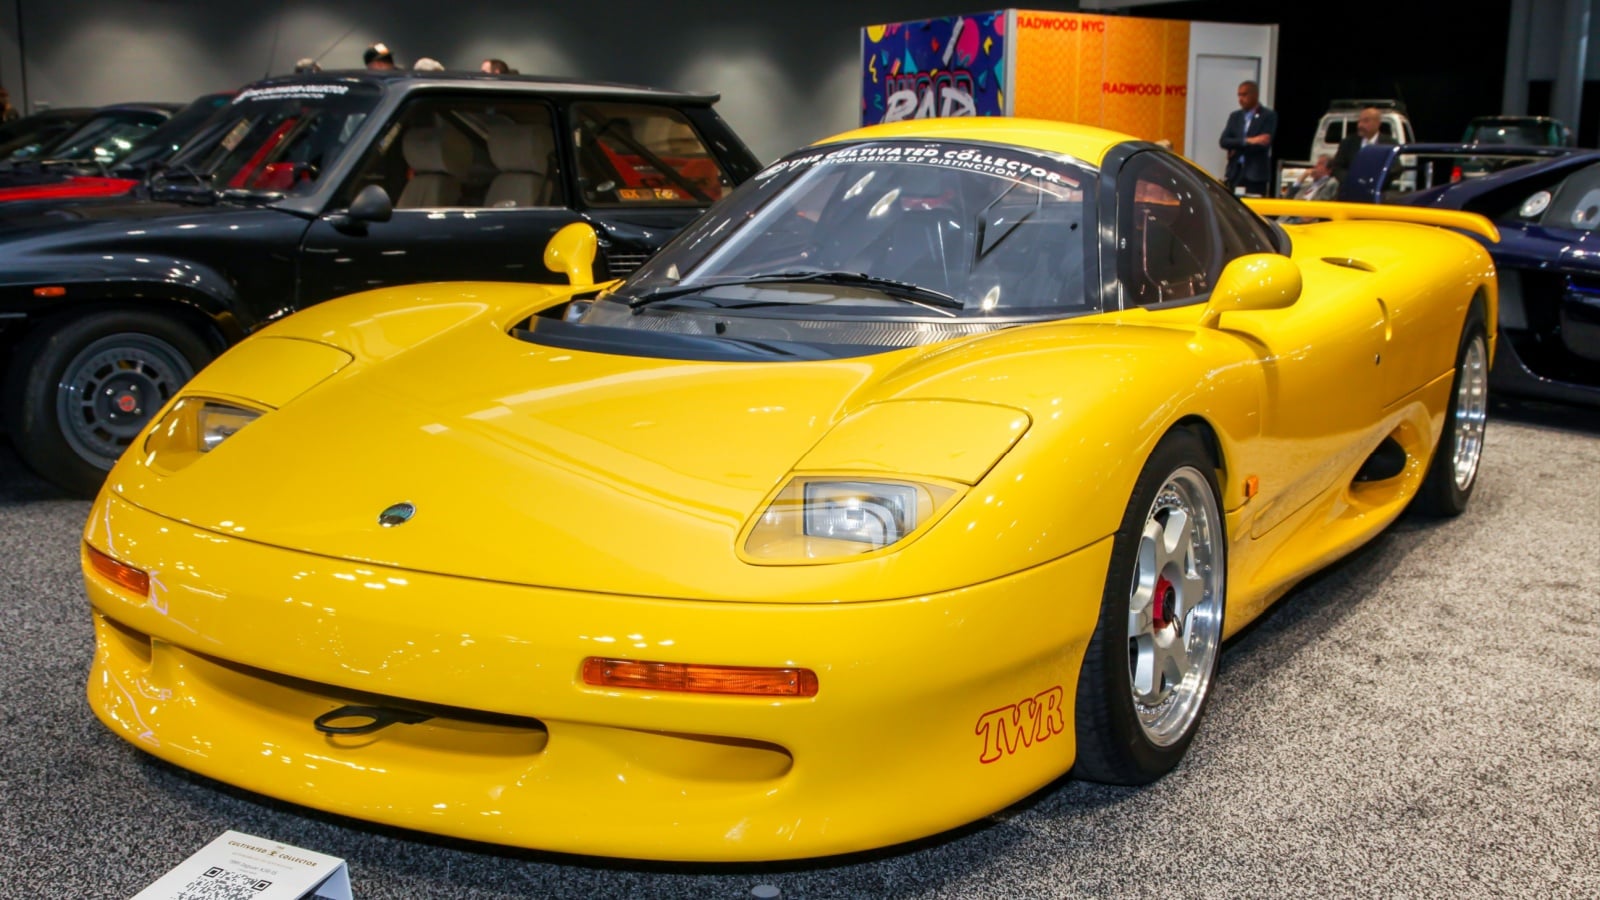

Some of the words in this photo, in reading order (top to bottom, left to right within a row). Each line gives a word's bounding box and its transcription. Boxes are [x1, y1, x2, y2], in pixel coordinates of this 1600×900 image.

[1016, 16, 1078, 32] RADWOOD
[1081, 20, 1105, 33] NYC
[1103, 82, 1162, 96] RADWOOD
[1166, 84, 1187, 97] NYC
[880, 86, 977, 124] RAD
[789, 154, 824, 168] THE
[825, 147, 940, 159] CULTIVATED
[943, 150, 1061, 183] COLLECTOR
[812, 155, 901, 167] AUTOMOBILES
[928, 157, 1018, 177] DISTINCTION
[975, 685, 1065, 764] TWR
[228, 840, 268, 854] CULTIVATED
[278, 853, 318, 867] COLLECTOR
